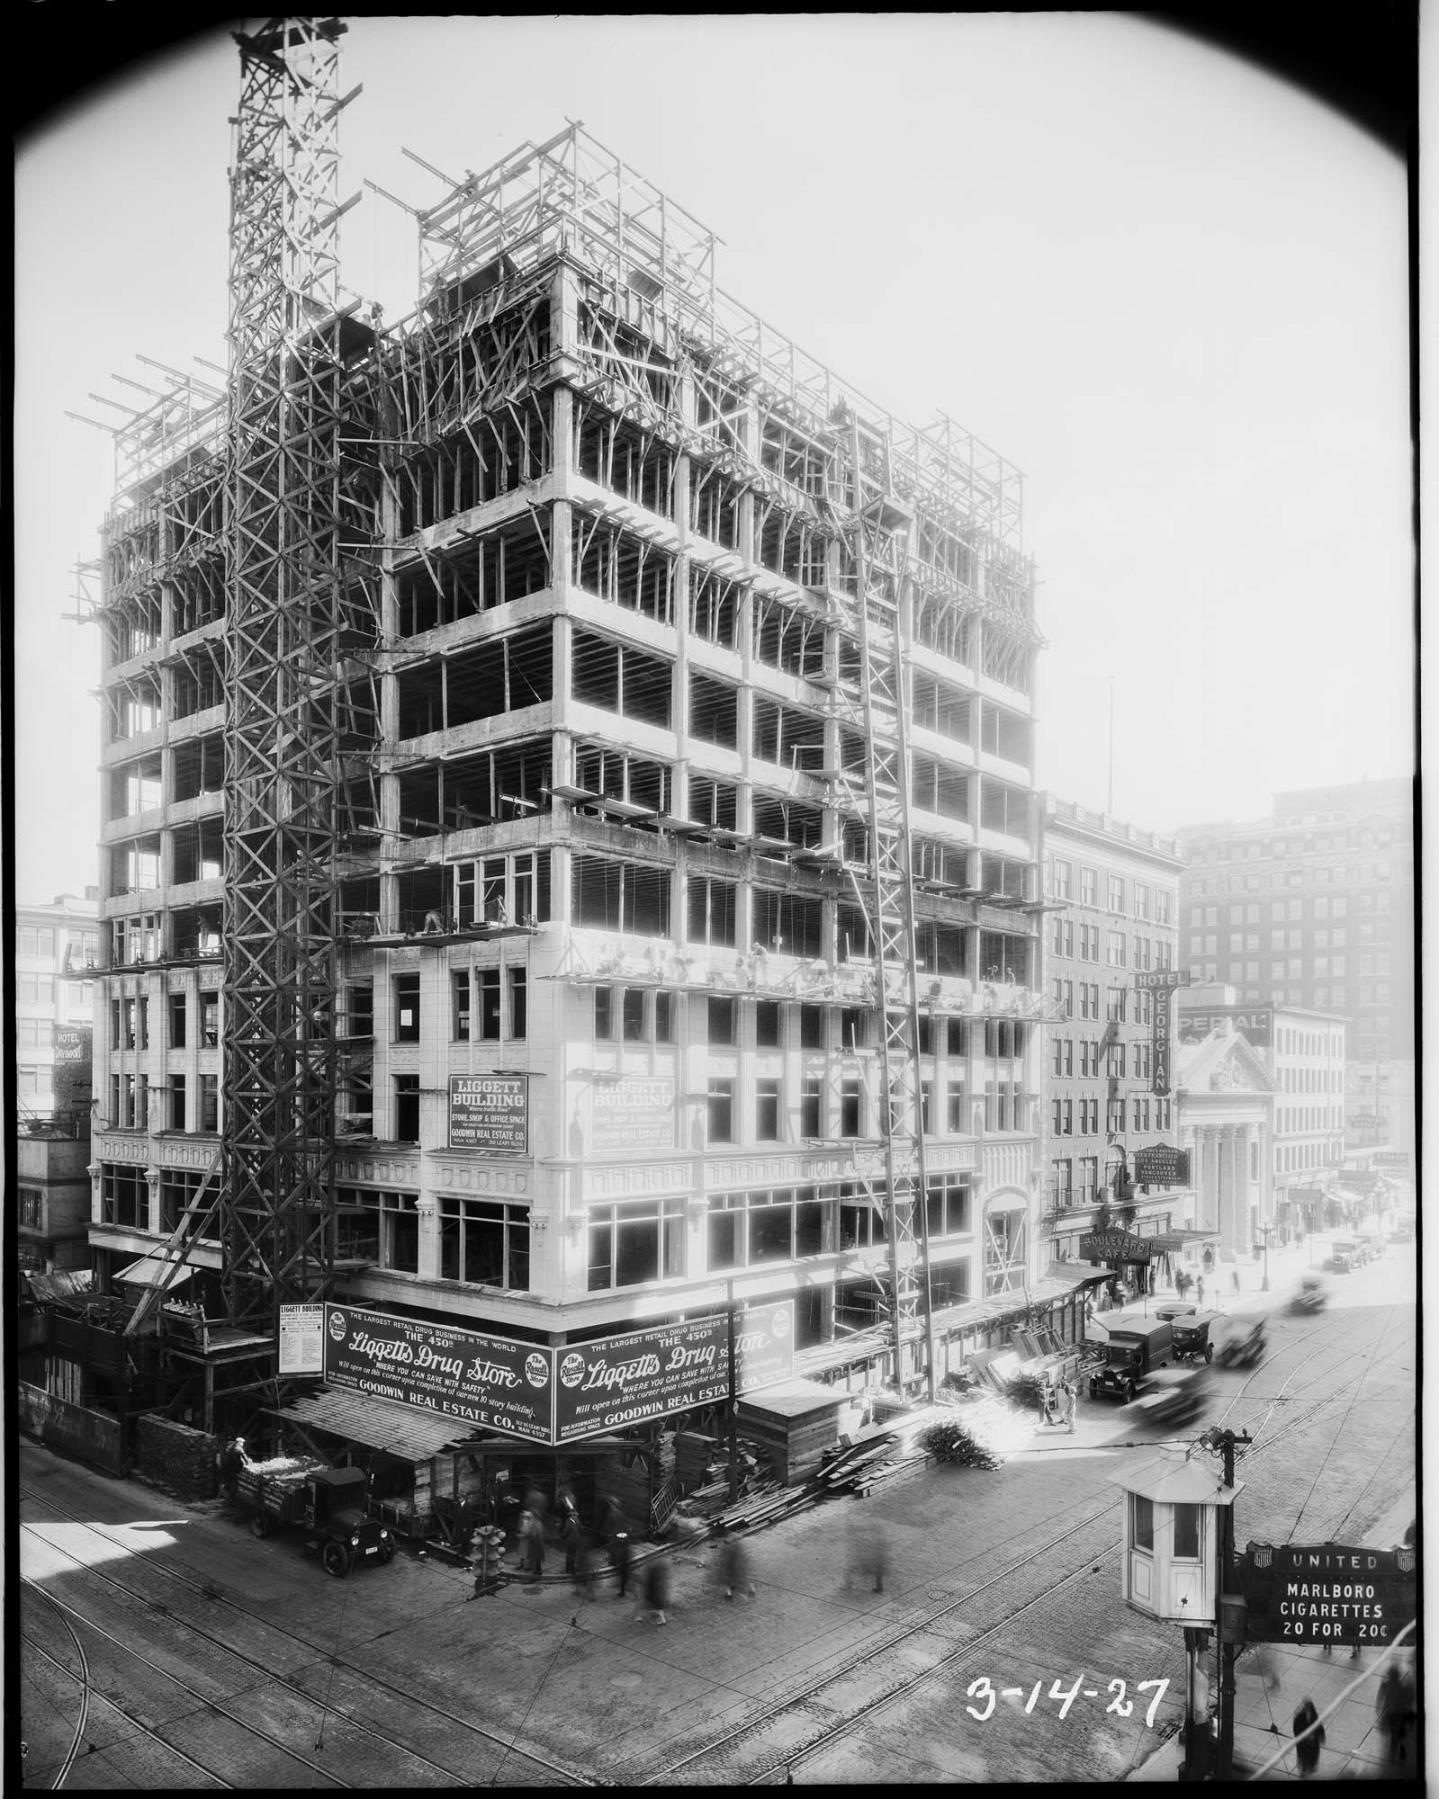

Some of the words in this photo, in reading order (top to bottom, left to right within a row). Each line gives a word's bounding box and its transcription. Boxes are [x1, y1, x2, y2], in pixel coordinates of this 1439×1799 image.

[1139, 973, 1186, 987] HOTEL
[57, 1033, 79, 1043] HOTEL
[1156, 990, 1166, 1089] GEORGIAN
[457, 1080, 520, 1093] LIGGETT
[452, 1093, 525, 1107] BUILDING
[594, 1094, 673, 1107] BUILDING
[484, 1114, 490, 1122] &
[490, 1115, 508, 1123] OFFICE
[509, 1115, 525, 1124] SPACE
[477, 1129, 491, 1139] REAL
[492, 1130, 514, 1140] ESTATE
[1098, 1248, 1129, 1260] CAFE
[281, 1305, 301, 1313] LIGGETT
[350, 1312, 362, 1320] THE
[364, 1315, 391, 1326] LARGEST
[393, 1321, 413, 1331] RETAIL
[415, 1326, 433, 1335] DRUG
[435, 1329, 465, 1342] BUSINESS
[468, 1336, 474, 1344] IN
[476, 1338, 488, 1347] THE
[491, 1342, 517, 1352] WORLD
[404, 1330, 423, 1342] THE
[591, 1344, 606, 1352] THE
[610, 1337, 642, 1349] LARGEST
[645, 1332, 667, 1341] RETAIL
[670, 1327, 688, 1336] DRUG
[690, 1321, 720, 1331] BUSINESS
[658, 1335, 682, 1348] THE
[665, 1345, 716, 1371] Drug
[414, 1344, 463, 1380] Drug
[466, 1357, 522, 1388] Store
[397, 1366, 409, 1376] YOU
[411, 1370, 426, 1380] CAN
[427, 1374, 442, 1385] SAVE
[445, 1377, 460, 1388] WITH
[651, 1378, 664, 1387] YOU
[665, 1373, 680, 1384] CAN
[681, 1369, 699, 1380] SAVE
[700, 1365, 715, 1375] WITH
[338, 1360, 349, 1369] Will
[371, 1367, 380, 1377] this
[382, 1371, 401, 1382] corner
[416, 1380, 447, 1393] completion
[456, 1390, 467, 1399] our
[467, 1394, 479, 1402] new
[480, 1395, 488, 1404] 10
[488, 1398, 505, 1411] story
[576, 1402, 590, 1415] Will
[592, 1400, 610, 1411] open
[612, 1397, 621, 1406] on
[622, 1393, 636, 1403] this
[637, 1388, 659, 1399] corner
[661, 1384, 677, 1394] upon
[677, 1376, 709, 1390] completion
[359, 1379, 404, 1400] GOODWIN
[409, 1391, 439, 1409] REAL
[443, 1400, 489, 1422] ESTATE
[493, 1414, 515, 1430] CO.
[604, 1401, 663, 1425] GOODWIN
[668, 1392, 696, 1408] REAL
[1292, 1554, 1378, 1569] UNITED
[1287, 1584, 1375, 1598] MARLBORO
[1280, 1602, 1383, 1618] CIGARETTES
[1283, 1622, 1304, 1635] 20
[1312, 1622, 1342, 1637] FOR
